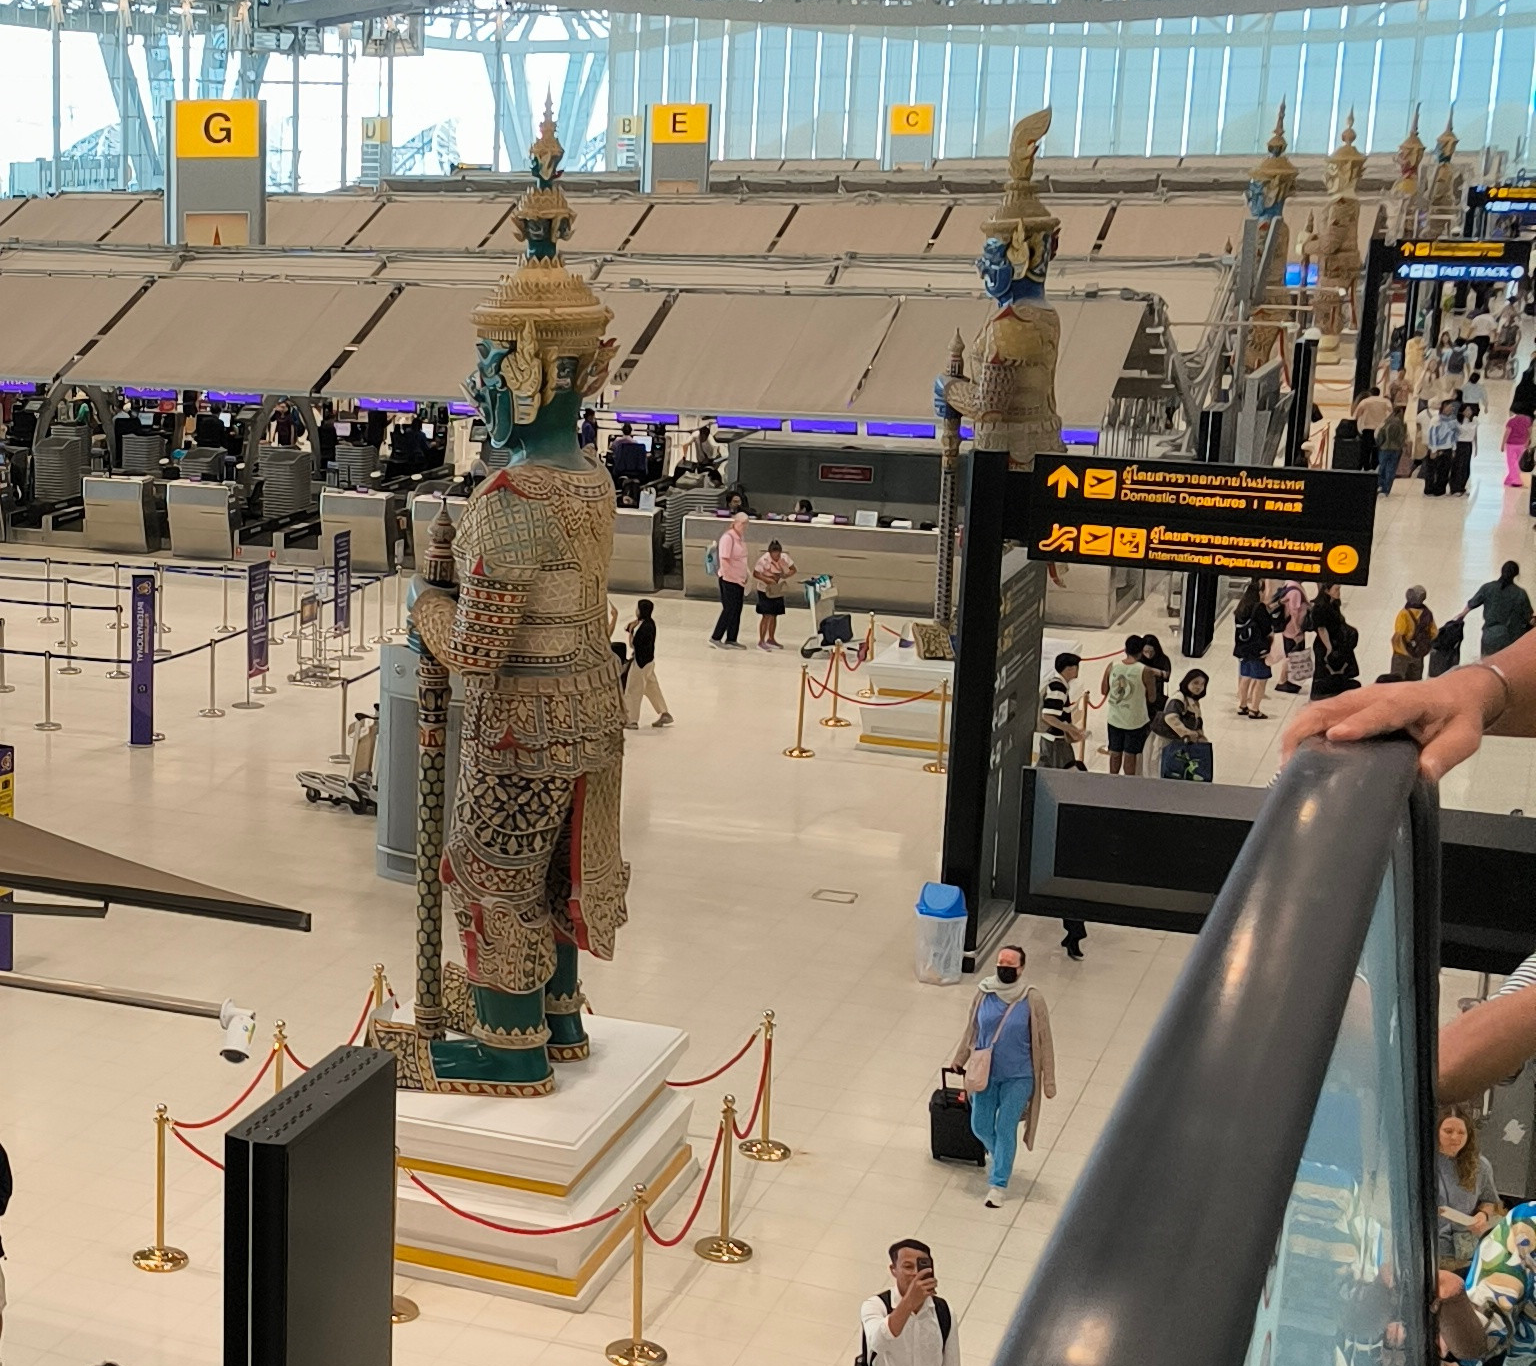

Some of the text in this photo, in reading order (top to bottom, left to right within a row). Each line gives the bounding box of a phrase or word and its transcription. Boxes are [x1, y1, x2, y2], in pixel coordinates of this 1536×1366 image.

[203, 112, 232, 144] G
[622, 118, 632, 134] B
[671, 112, 688, 133] E
[906, 110, 920, 127] C
[1439, 265, 1510, 278] FAST TRACK
[1120, 490, 1247, 509] Domestic Departures
[1148, 550, 1213, 566] International
[1214, 554, 1274, 570] Departures
[1337, 552, 1348, 565] 2
[136, 601, 145, 663] INTERNATIONAL
